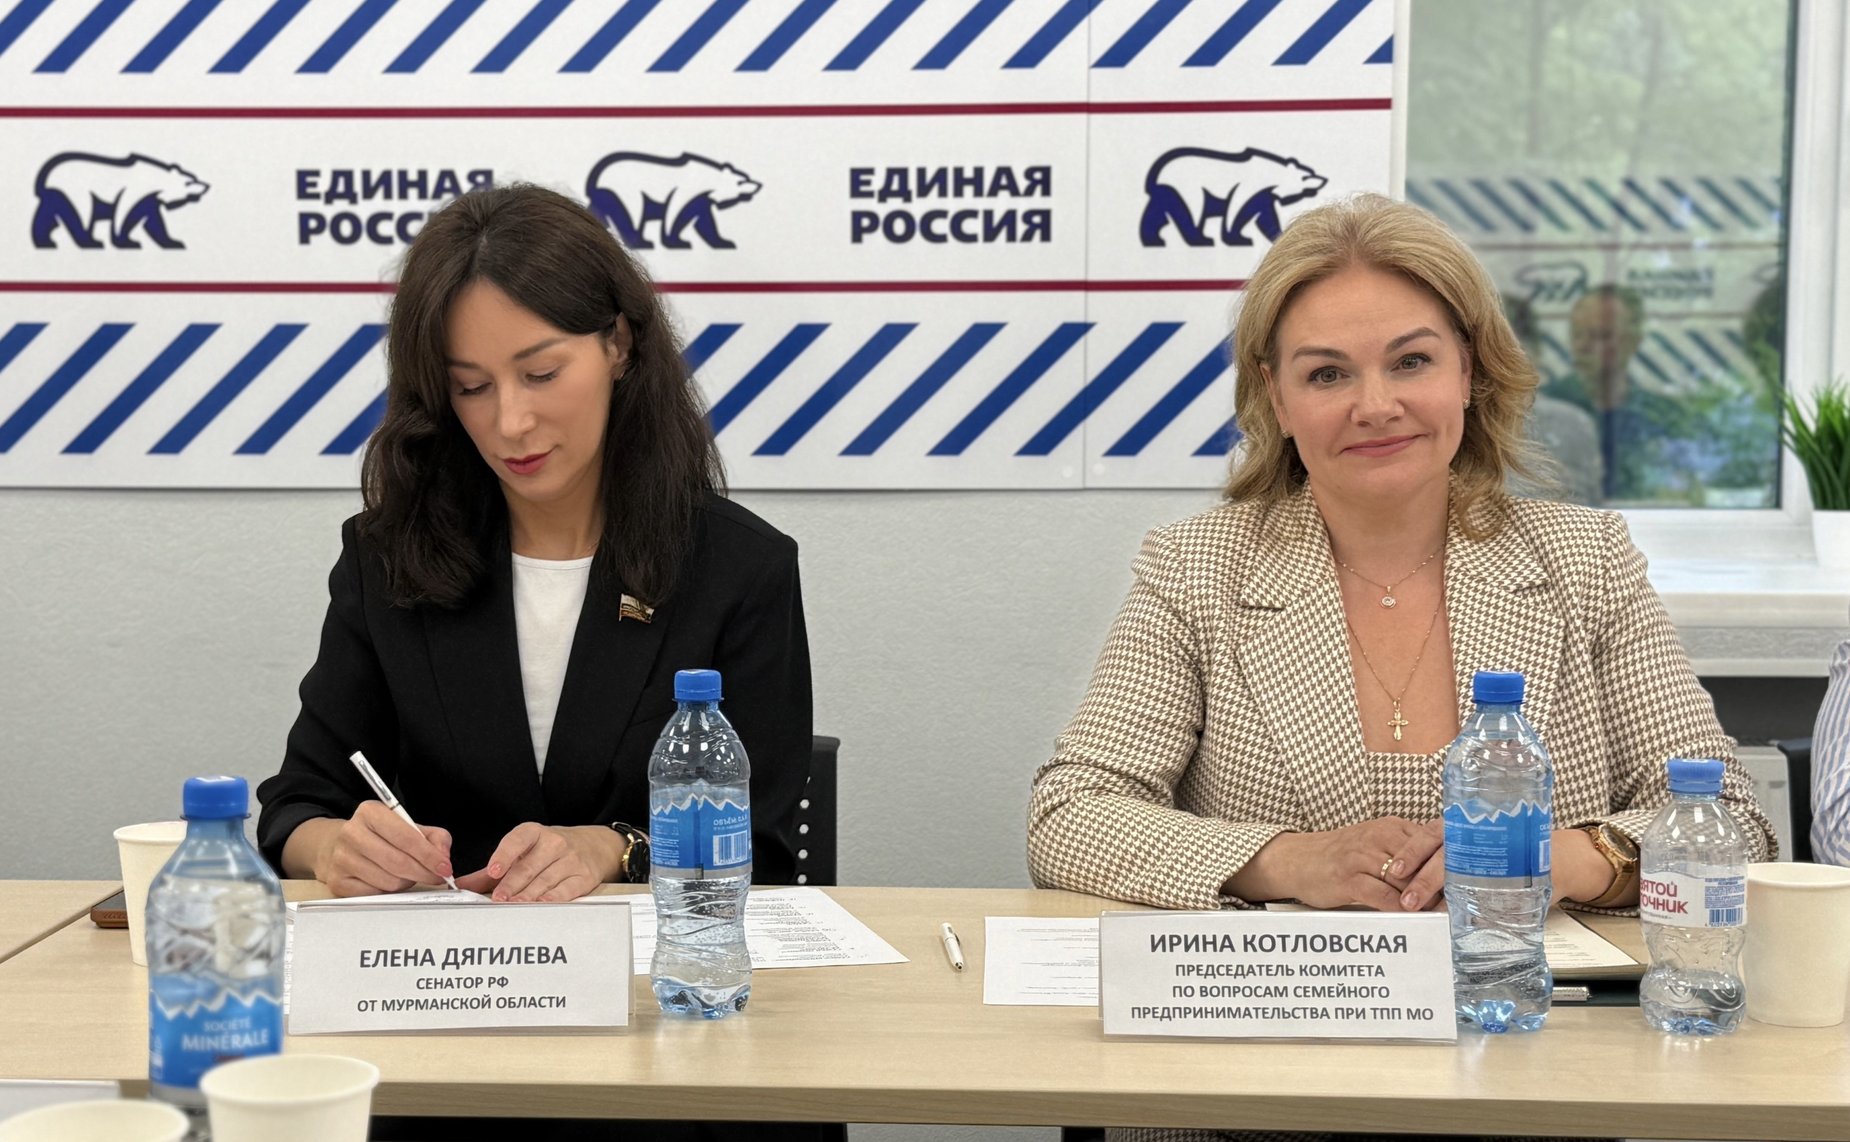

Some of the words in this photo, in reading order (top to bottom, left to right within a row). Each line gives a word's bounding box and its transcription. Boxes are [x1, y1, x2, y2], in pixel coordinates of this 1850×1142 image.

[296, 169, 494, 205] ЕДИНАЯ
[849, 166, 1052, 203] ЕДИНАЯ
[298, 211, 435, 245] РОСС
[851, 208, 1052, 244] РОССИЯ
[1640, 893, 1689, 914] ОЧНИК
[1150, 934, 1236, 953] ИРИНА
[1243, 934, 1408, 953] КОТЛОВСКАЯ
[359, 948, 436, 968] ЕЛЕНА
[441, 946, 568, 970] ДЯГИЛЕВА
[1175, 964, 1296, 979] ПРЕДСЕДАТЕЛЬ
[1299, 964, 1386, 978] КОМИТЕТА
[416, 977, 484, 990] СЕНАТОР
[487, 976, 509, 989] РФ
[1172, 985, 1195, 998] ПО
[1199, 985, 1289, 998] ВОПРОСАМ
[1293, 983, 1390, 999] СЕМЕЙНОГО
[357, 999, 377, 1012] ОТ
[381, 994, 492, 1012] МУРМАНСКОЙ
[496, 996, 567, 1010] ОБЛАСТИ
[1131, 1007, 1330, 1021] ПРЕДПРИНИМАТЕЛЬСТВА
[1334, 1007, 1367, 1020] ПРИ
[1370, 1007, 1402, 1020] ТПП
[1406, 1008, 1434, 1021] МО
[182, 1028, 269, 1051] MINÉRALE
